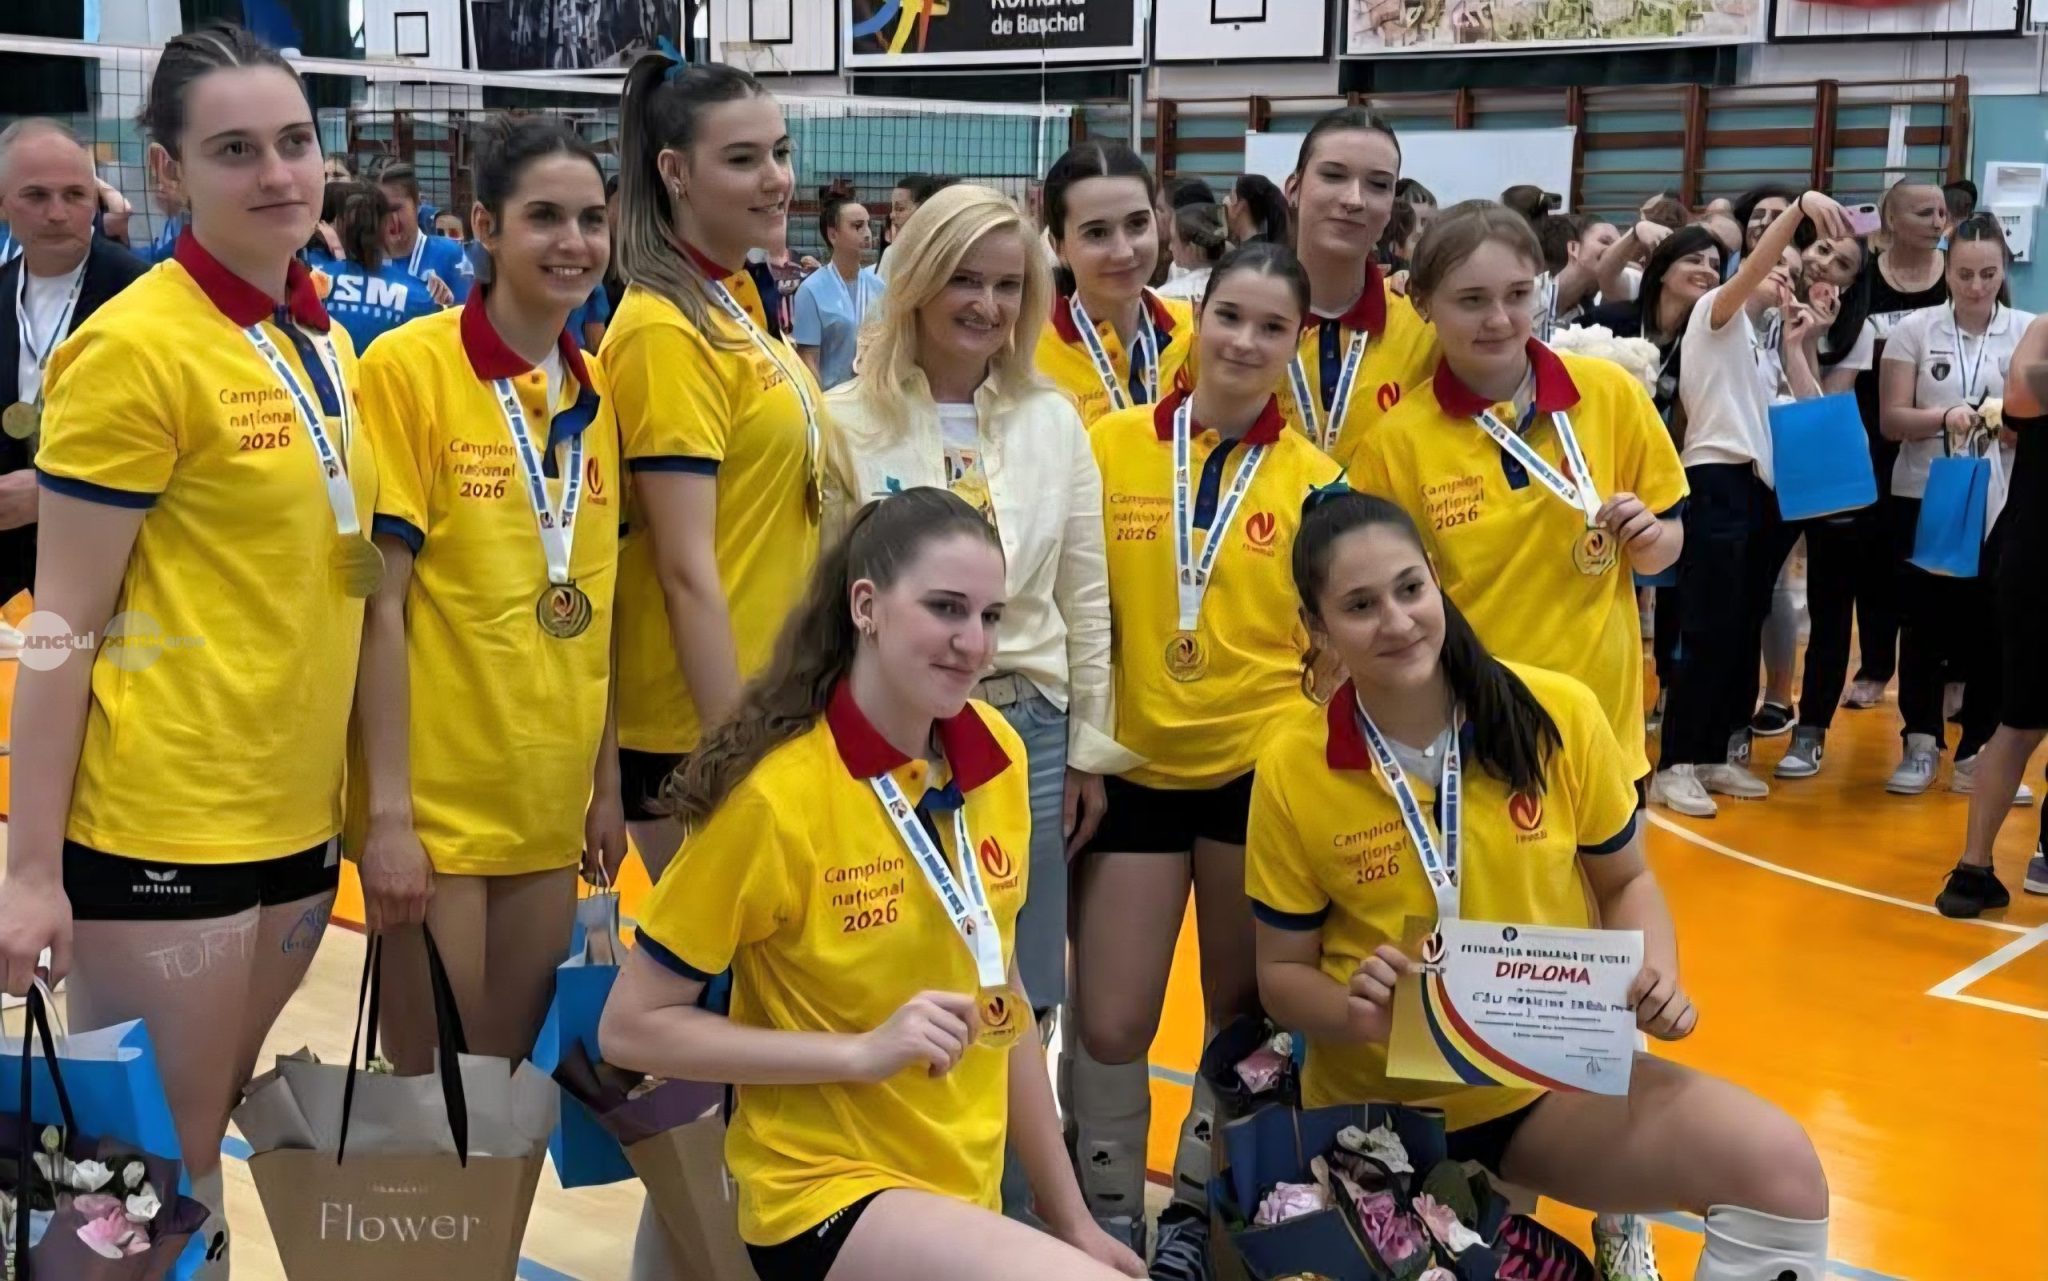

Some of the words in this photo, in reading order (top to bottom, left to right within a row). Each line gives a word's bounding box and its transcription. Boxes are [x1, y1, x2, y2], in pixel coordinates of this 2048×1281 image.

[326, 274, 408, 312] SM
[240, 427, 290, 451] 2026
[460, 480, 505, 498] 2026
[1435, 504, 1478, 531] 2026
[1116, 525, 1157, 541] 2026
[825, 855, 904, 885] Campion
[1356, 855, 1400, 884] 2026
[843, 898, 898, 934] 2026
[1495, 961, 1591, 985] DIPLOMA
[321, 1201, 481, 1242] Flower
